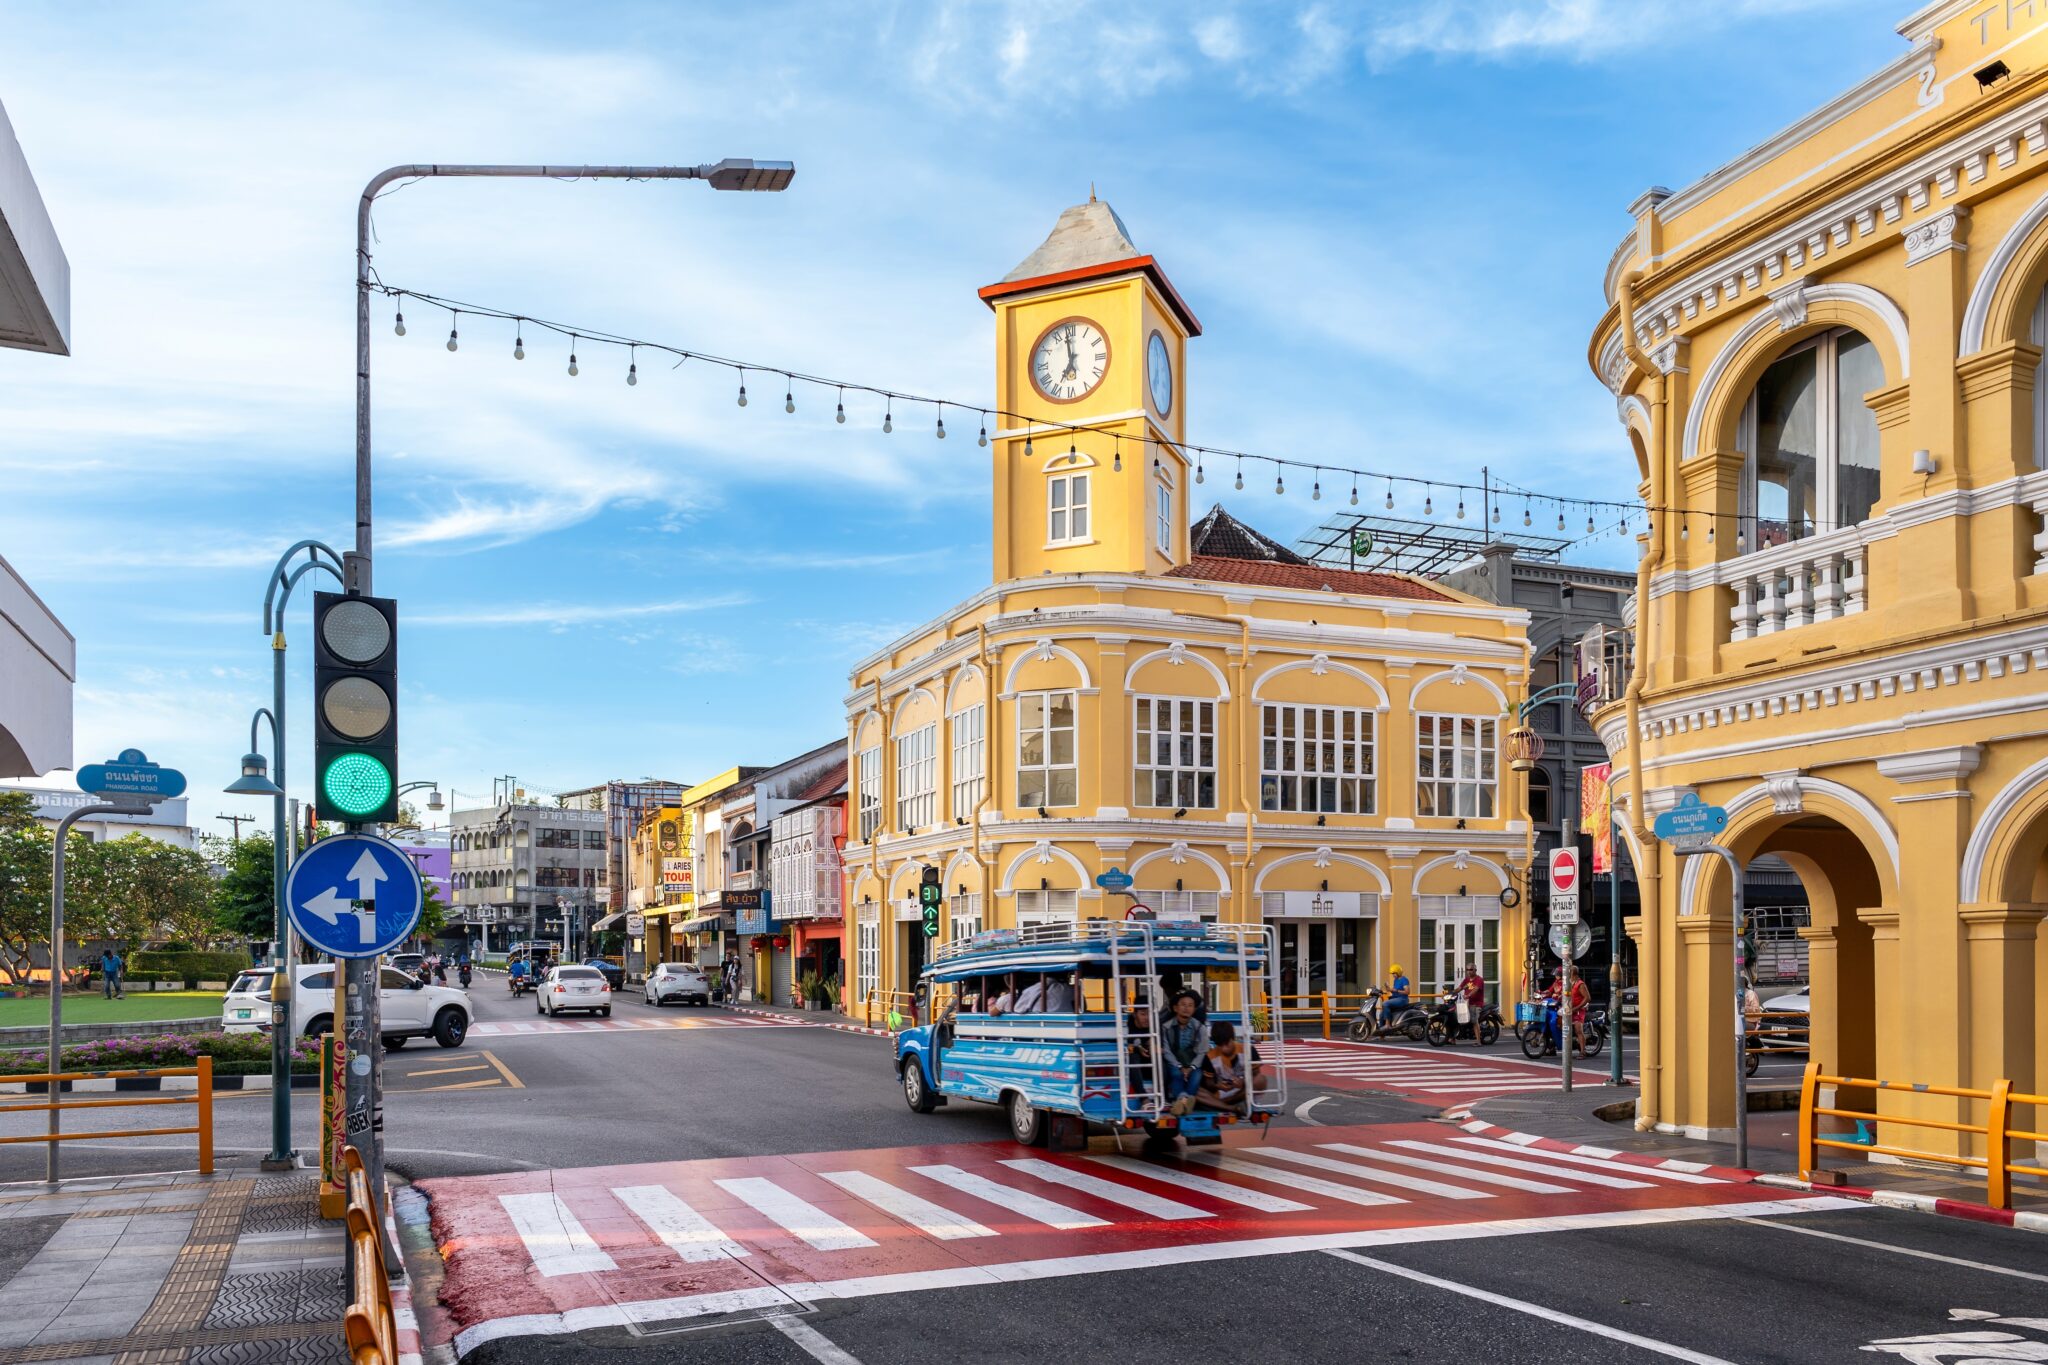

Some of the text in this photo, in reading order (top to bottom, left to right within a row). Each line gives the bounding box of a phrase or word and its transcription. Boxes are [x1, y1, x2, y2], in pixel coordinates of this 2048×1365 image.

[1971, 0, 2048, 46] TH
[1091, 337, 1102, 347] II
[1095, 353, 1106, 361] III
[105, 770, 158, 783] ถนนพังงา
[673, 862, 692, 870] ARIES
[664, 873, 692, 882] TOUR
[924, 888, 939, 900] 31
[1552, 897, 1577, 911] ห้ามเข้า
